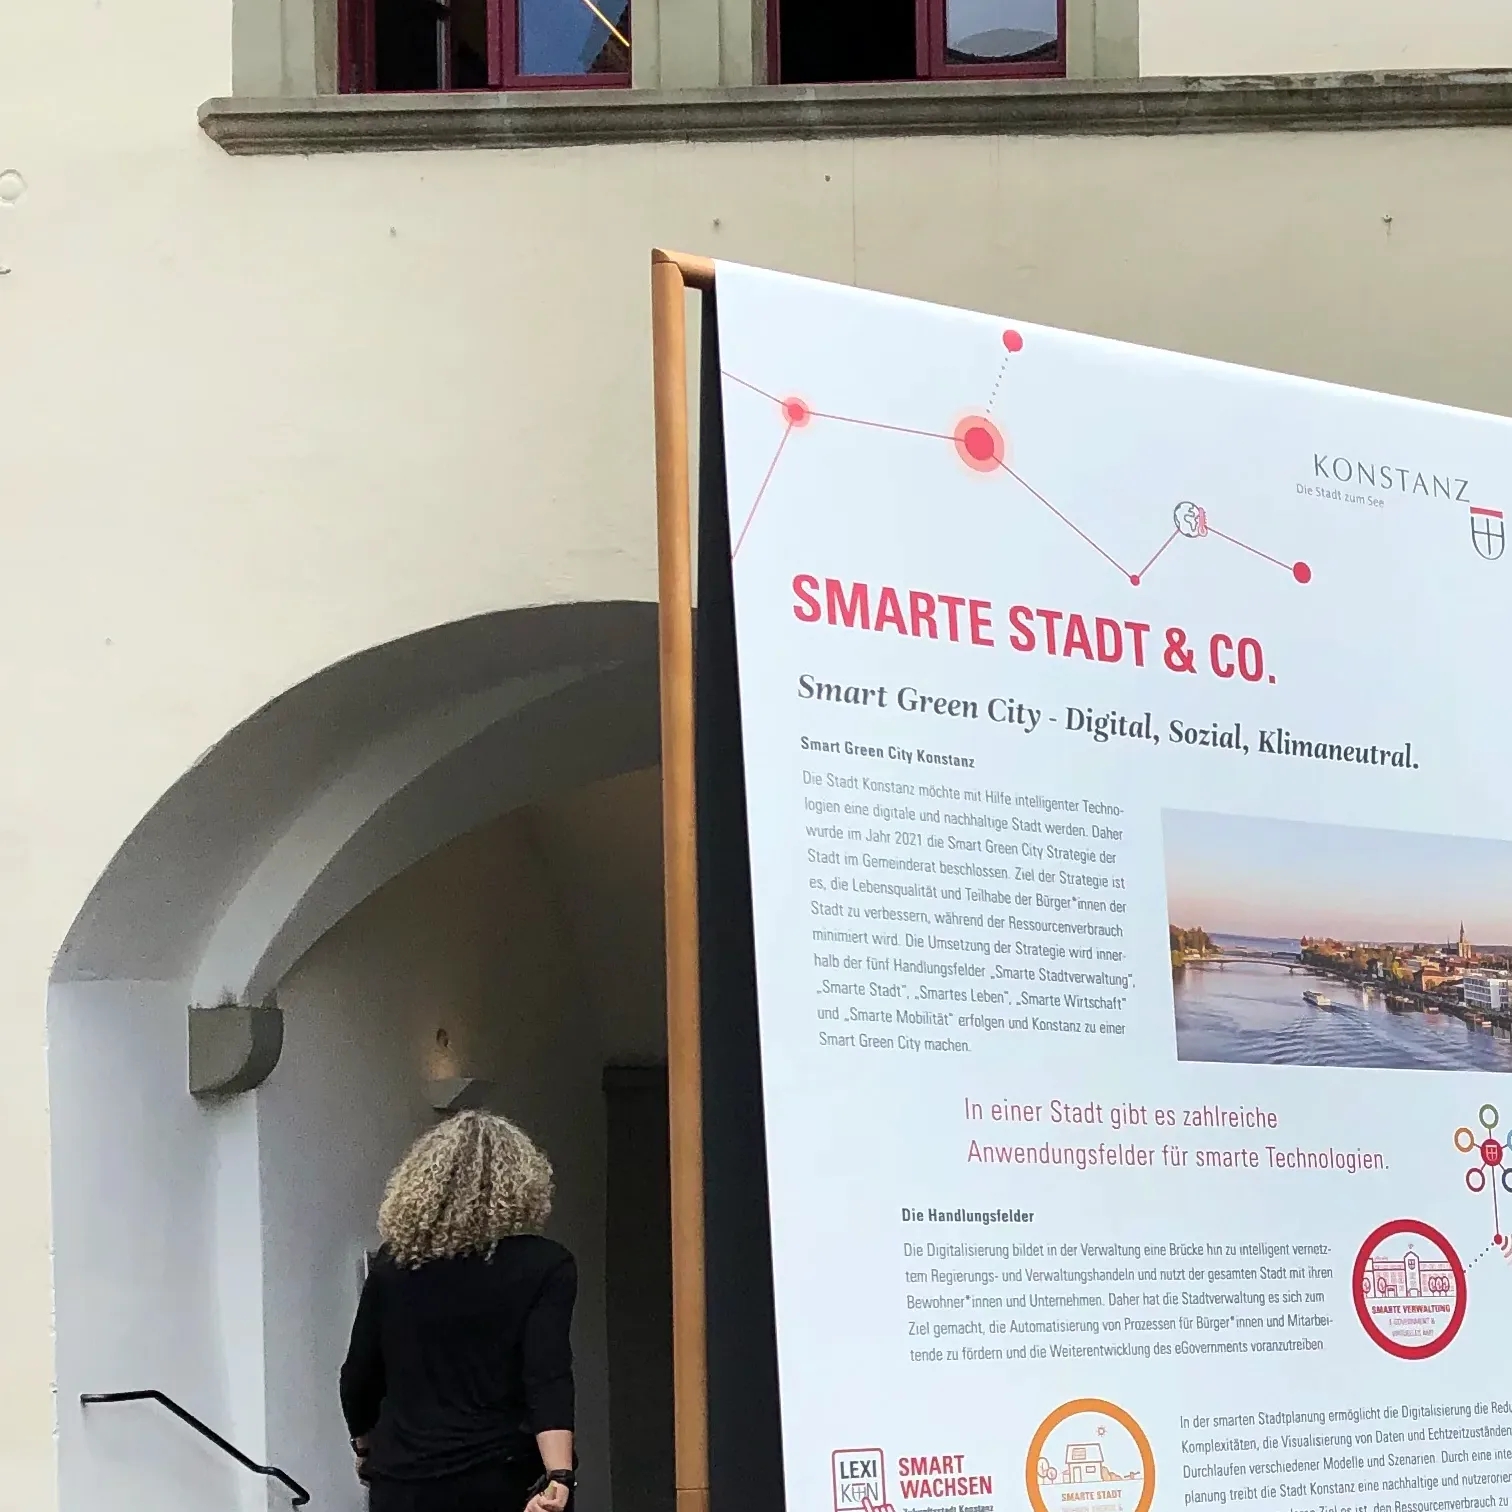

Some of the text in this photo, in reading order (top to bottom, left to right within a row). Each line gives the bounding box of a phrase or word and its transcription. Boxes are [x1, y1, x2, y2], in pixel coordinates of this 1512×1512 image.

[1314, 453, 1470, 503] KONSTANZ
[1296, 483, 1385, 508] Die Stadt zum See
[792, 574, 1276, 685] SMARTE STADT & CO.
[798, 674, 1419, 770] Smart Green City Digital, Sozial, Klimaneutral.
[800, 735, 975, 769] Smart Green City Konstanz
[805, 824, 1117, 865] wurde im Jahr 2021 die Smart Green City Strategie der
[965, 1097, 1278, 1130] In einer Stadt gibt es zahlreiche
[967, 1139, 1389, 1174] Anwendungsfelder für smarte Technologien.
[901, 1207, 1034, 1226] Die Handlungsfelder
[1005, 1293, 1026, 1308] und
[1108, 1292, 1140, 1306] Daher
[1142, 1292, 1160, 1306] hat
[1162, 1291, 1179, 1306] die
[1181, 1290, 1266, 1307] Stadtverwaltung
[1268, 1293, 1280, 1304] es
[1282, 1289, 1303, 1304] sich
[1304, 1292, 1325, 1303] zum
[1371, 1304, 1451, 1315] SMARTE VERWALTUNG
[840, 1459, 877, 1480] LEXI
[898, 1454, 965, 1477] SMART
[899, 1475, 993, 1500] WACHSEN
[1061, 1489, 1122, 1502] SMARTE STADT
